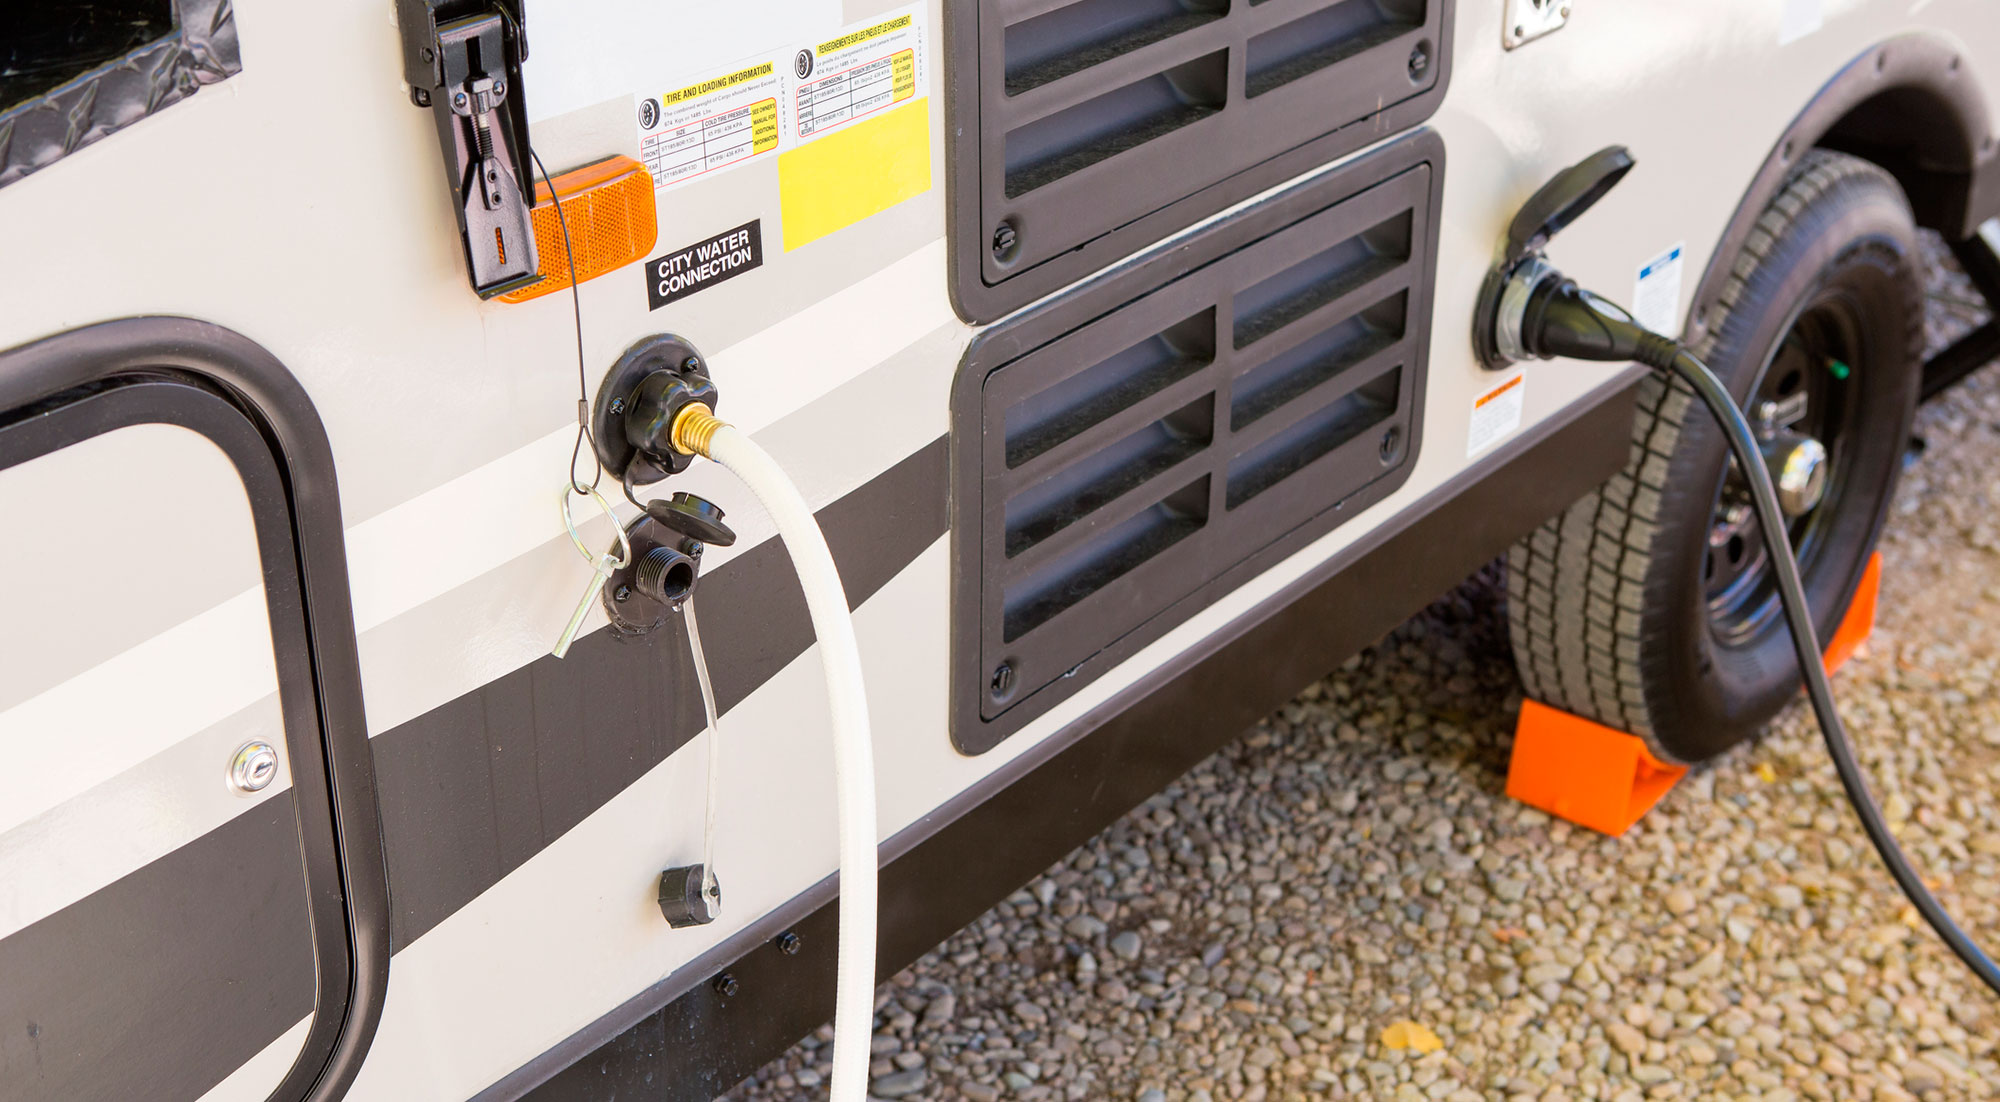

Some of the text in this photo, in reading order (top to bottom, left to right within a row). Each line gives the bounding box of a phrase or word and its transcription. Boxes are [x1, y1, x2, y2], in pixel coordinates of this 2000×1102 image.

[866, 27, 877, 38] PNEUS
[667, 63, 772, 103] TIRE AND LOADING INFORMATION
[819, 75, 842, 87] DIMENSIONS
[674, 104, 695, 115] combined
[696, 98, 711, 107] weight
[718, 93, 731, 101] Cargo
[732, 88, 747, 96] should
[761, 78, 776, 87] Exceed
[728, 108, 749, 118] PRESSURE
[759, 103, 775, 112] OWNER'S
[753, 117, 768, 125] MANUAL
[755, 125, 775, 135] ADDITIONAL
[754, 135, 777, 146] INFORMATION
[644, 150, 658, 159] FRONT
[658, 229, 749, 278] CITY WATER
[658, 246, 752, 297] CONNECTION
